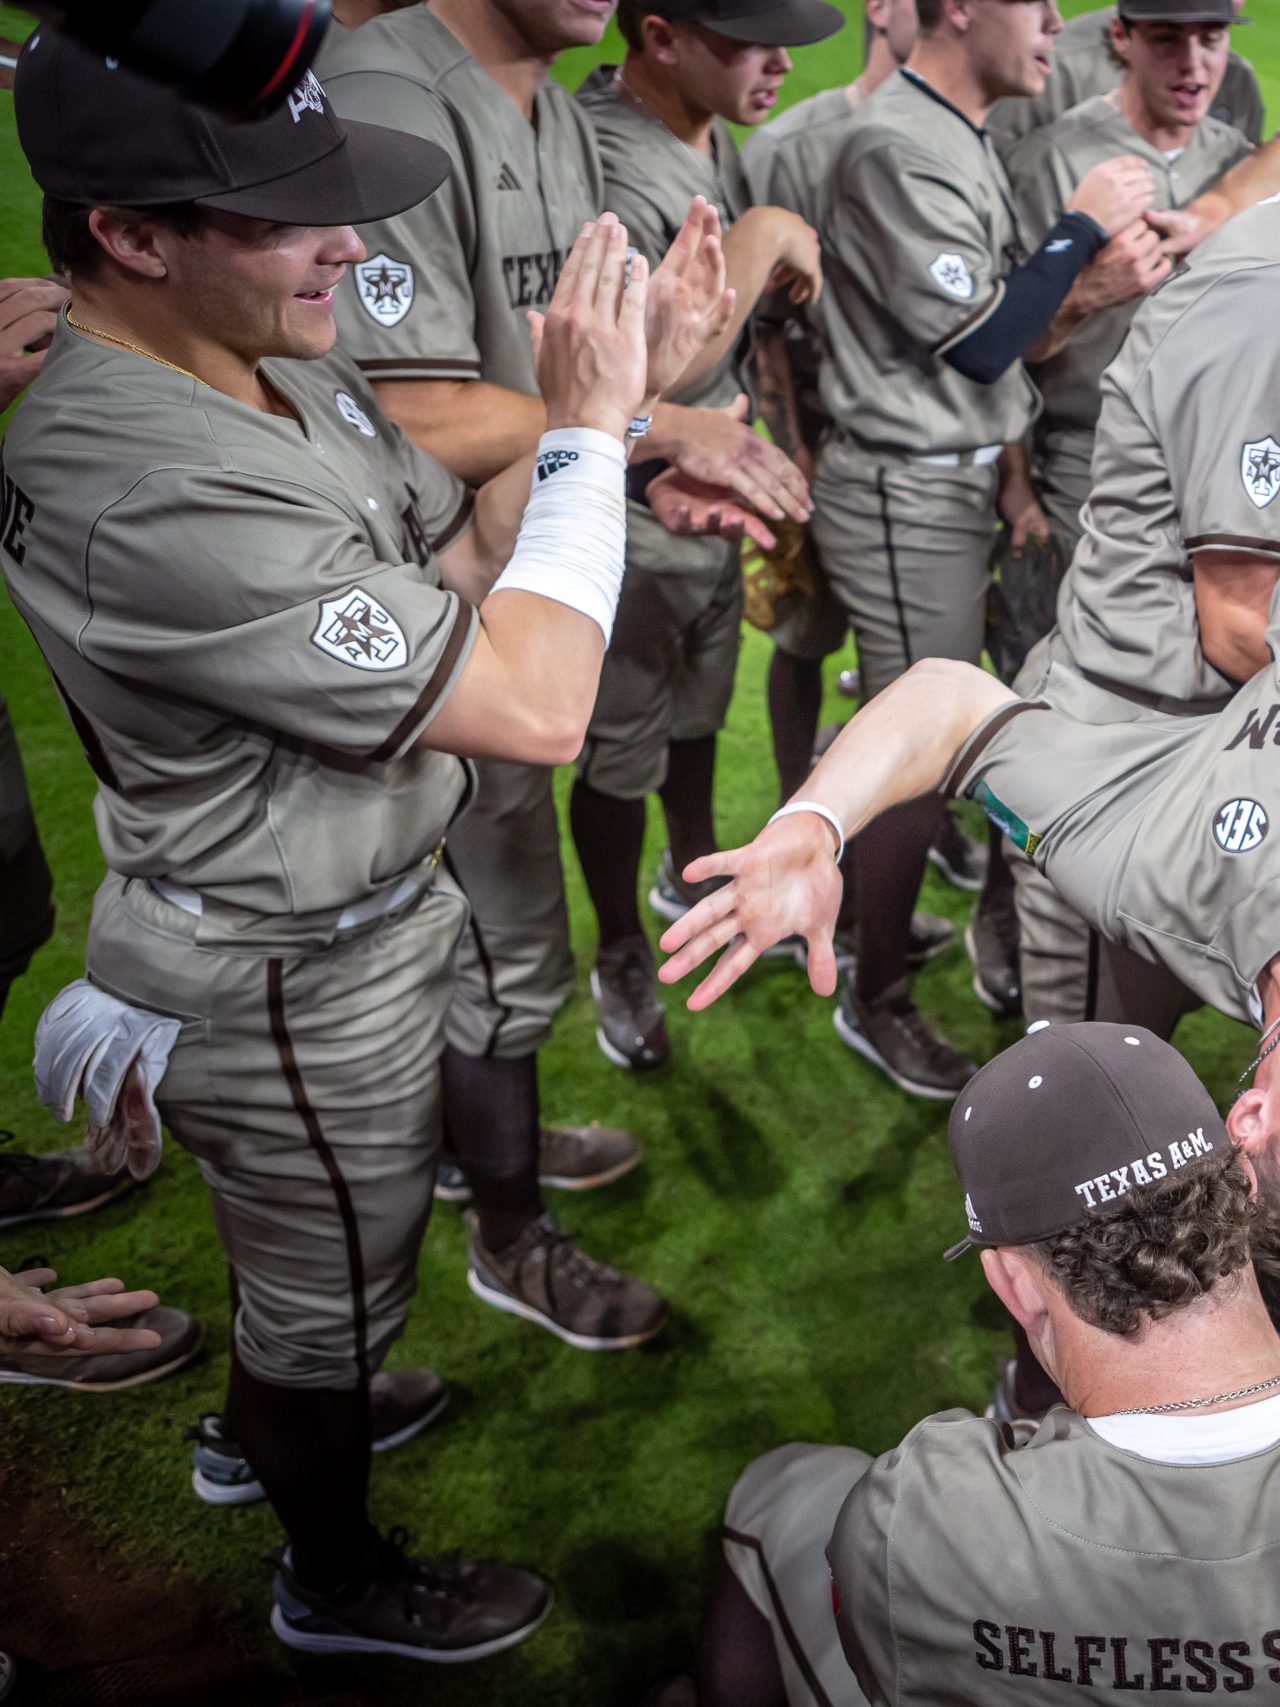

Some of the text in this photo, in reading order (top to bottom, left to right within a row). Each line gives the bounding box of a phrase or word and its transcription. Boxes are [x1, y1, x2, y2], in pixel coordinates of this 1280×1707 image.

[1214, 798, 1268, 852] SEC
[1074, 1151, 1168, 1208] TEXAS
[973, 1618, 1255, 1693] SELFLESS
